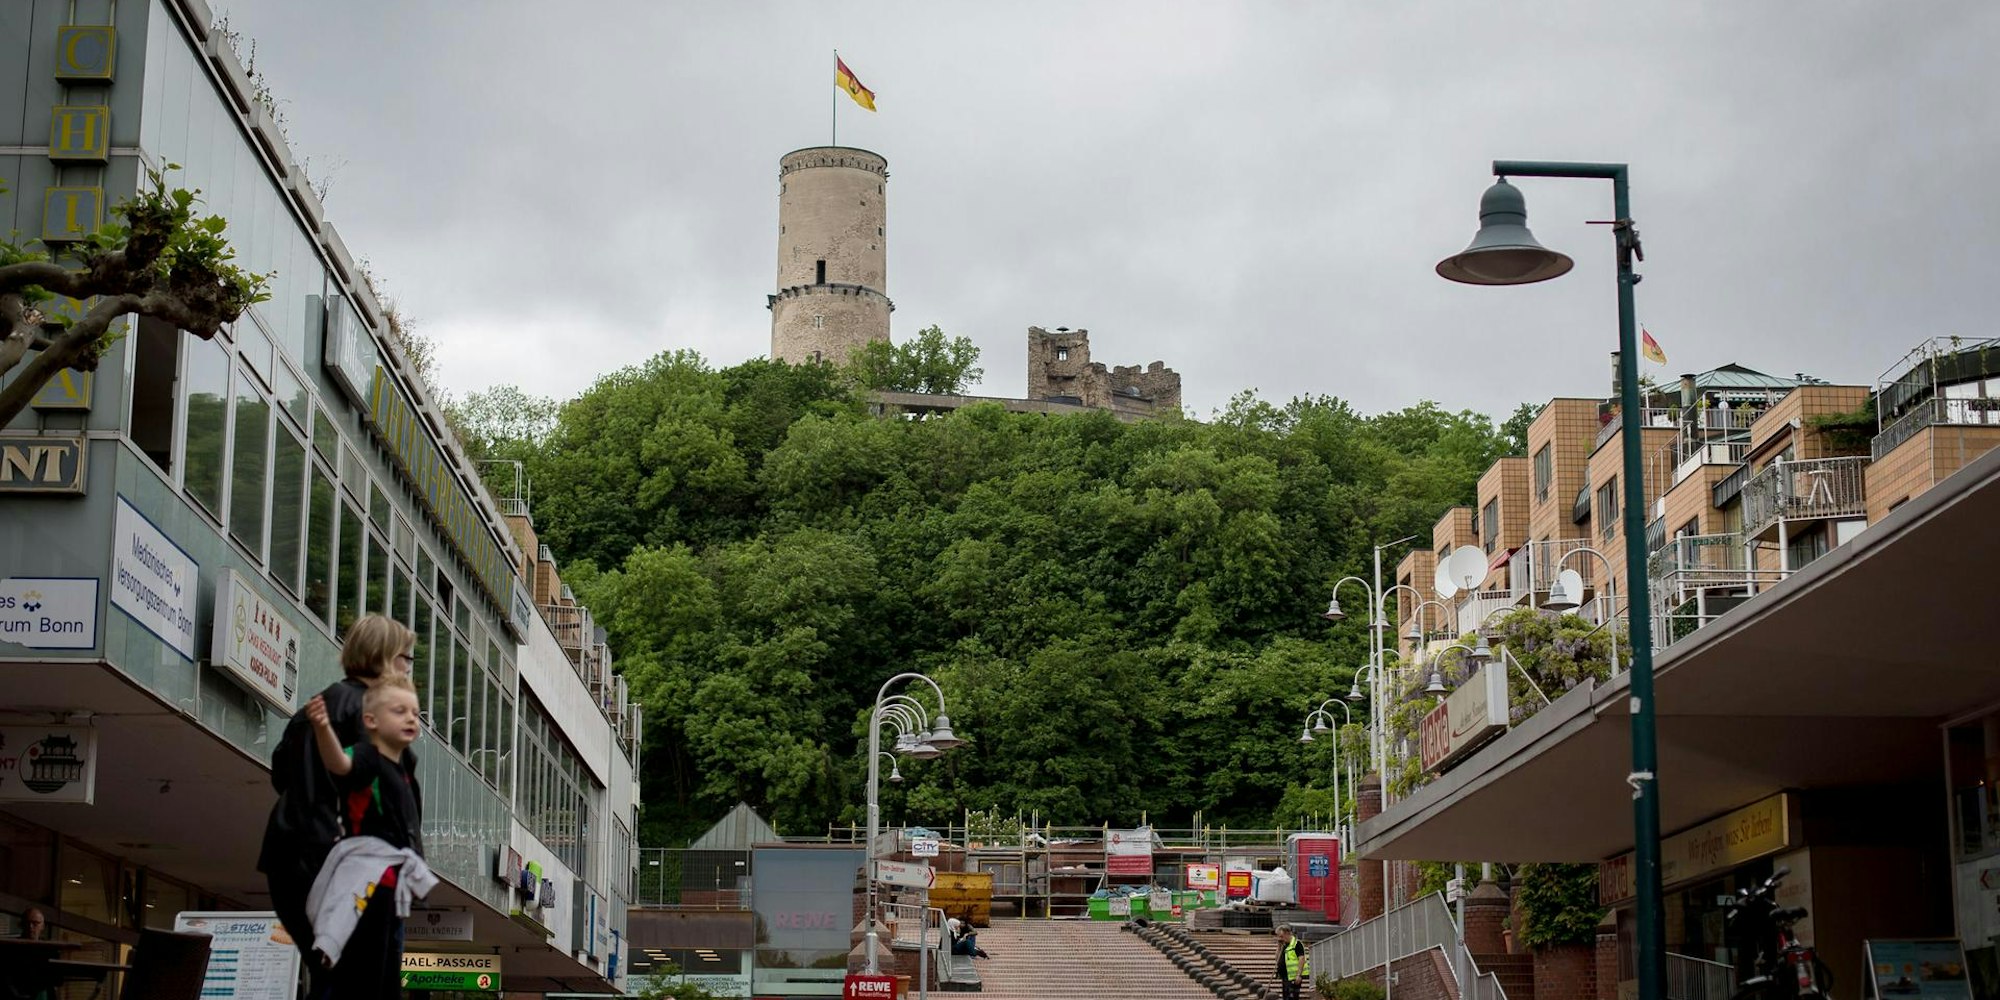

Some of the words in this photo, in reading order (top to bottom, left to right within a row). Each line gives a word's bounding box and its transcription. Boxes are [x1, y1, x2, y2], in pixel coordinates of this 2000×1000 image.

[46, 34, 103, 400] CHIA
[132, 532, 173, 587] Medizinisches
[117, 557, 176, 625] Versorgungszentrum
[178, 607, 193, 636] Bonn
[40, 618, 83, 632] Bonn
[776, 912, 836, 928] REWE
[410, 974, 465, 986] Apotheke
[859, 982, 891, 992] REWE
